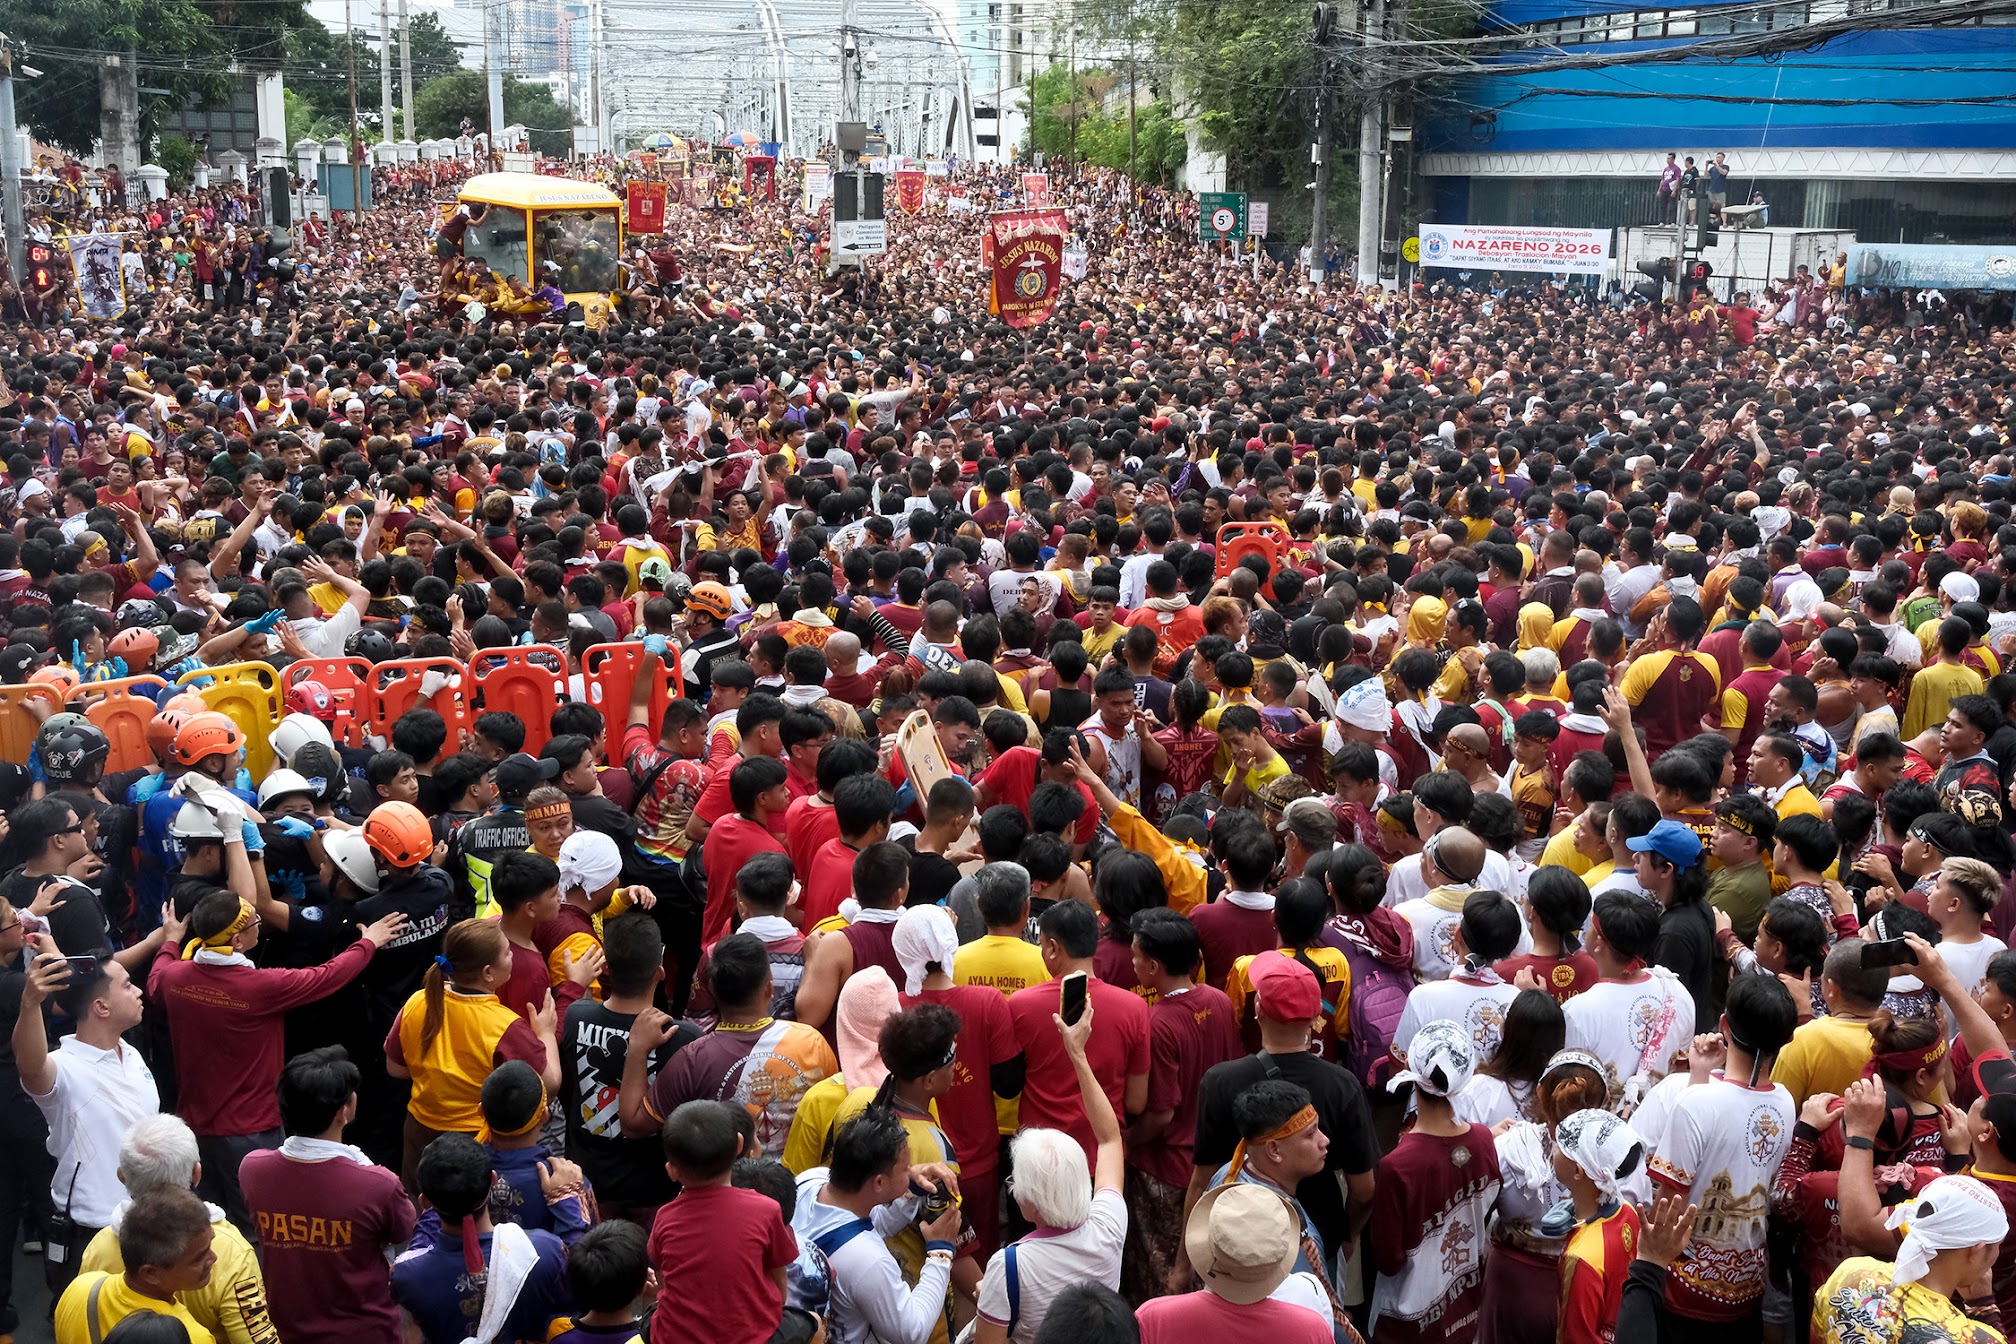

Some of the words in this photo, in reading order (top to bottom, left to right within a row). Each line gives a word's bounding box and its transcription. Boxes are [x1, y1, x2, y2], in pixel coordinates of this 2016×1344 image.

[539, 194, 562, 203] JESUS
[564, 193, 608, 202] NAZARENO
[1464, 228, 1477, 237] Ang
[1478, 228, 1521, 238] Pamahalaang
[1522, 229, 1551, 238] Lungsod
[1562, 230, 1593, 239] Maynila
[33, 247, 49, 261] 64
[1452, 239, 1550, 252] NAZARENO
[1554, 243, 1601, 255] 2026
[999, 244, 1022, 269] JESUS
[1690, 266, 1704, 279] 39
[1159, 626, 1173, 637] JC
[475, 828, 501, 848] TRAFFIC
[502, 827, 530, 846] OFFICER
[968, 976, 994, 987] AYALA
[997, 977, 1027, 990] HOMES
[723, 1055, 751, 1081] NATIONAL
[777, 1054, 788, 1062] OF
[787, 1059, 798, 1071] THE
[1968, 1189, 2000, 1213] NUESTRO
[256, 1211, 353, 1247] PASAN
[1684, 1262, 1699, 1276] at
[1700, 1268, 1721, 1281] Ako
